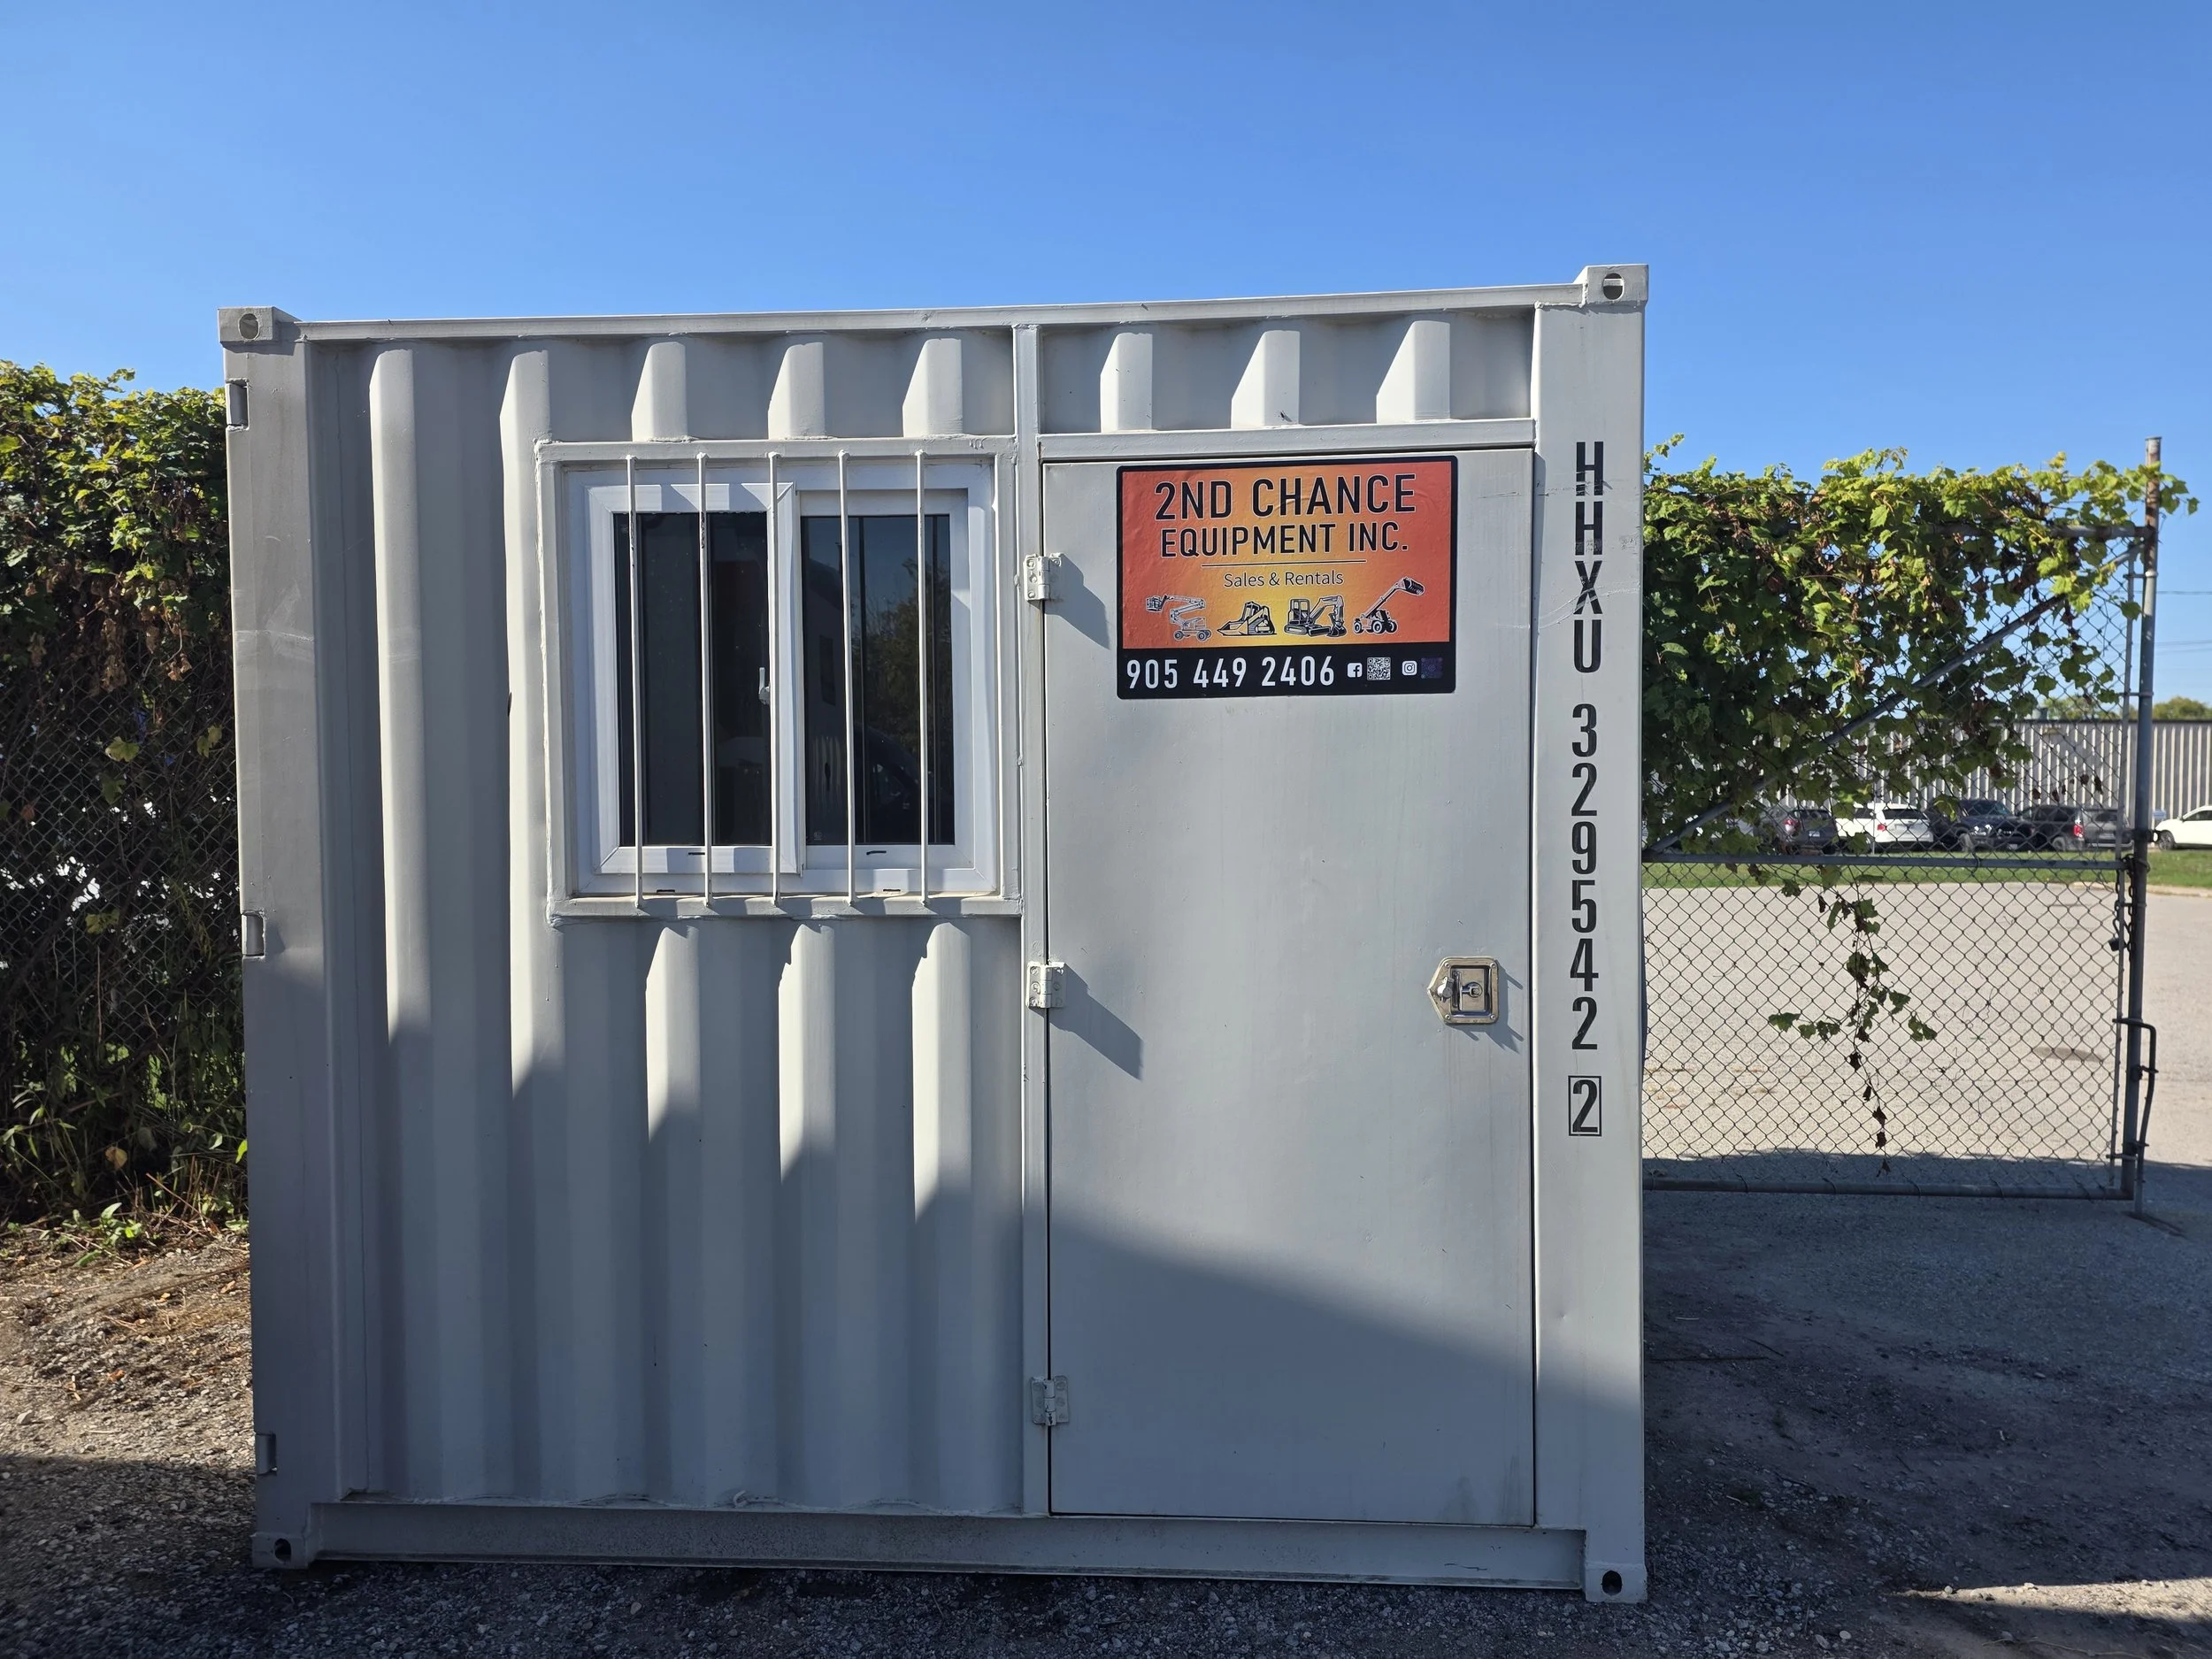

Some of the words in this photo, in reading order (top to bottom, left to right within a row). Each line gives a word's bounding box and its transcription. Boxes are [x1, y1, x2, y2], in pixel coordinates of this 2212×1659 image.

[1154, 480, 1233, 521] 2ND
[1251, 472, 1417, 518] CHANCE
[1160, 523, 1336, 558] EQUIPMENT
[1348, 520, 1409, 552] INC.
[1573, 441, 1604, 673] HHXU
[1224, 572, 1265, 588] Sales
[1269, 572, 1280, 586] &
[1284, 570, 1344, 586] Rentals
[1126, 658, 1179, 689] 905
[1193, 657, 1248, 688] 449
[1262, 656, 1334, 687] 2406
[1570, 703, 1599, 1050] 329542
[1571, 1079, 1599, 1133] 2
